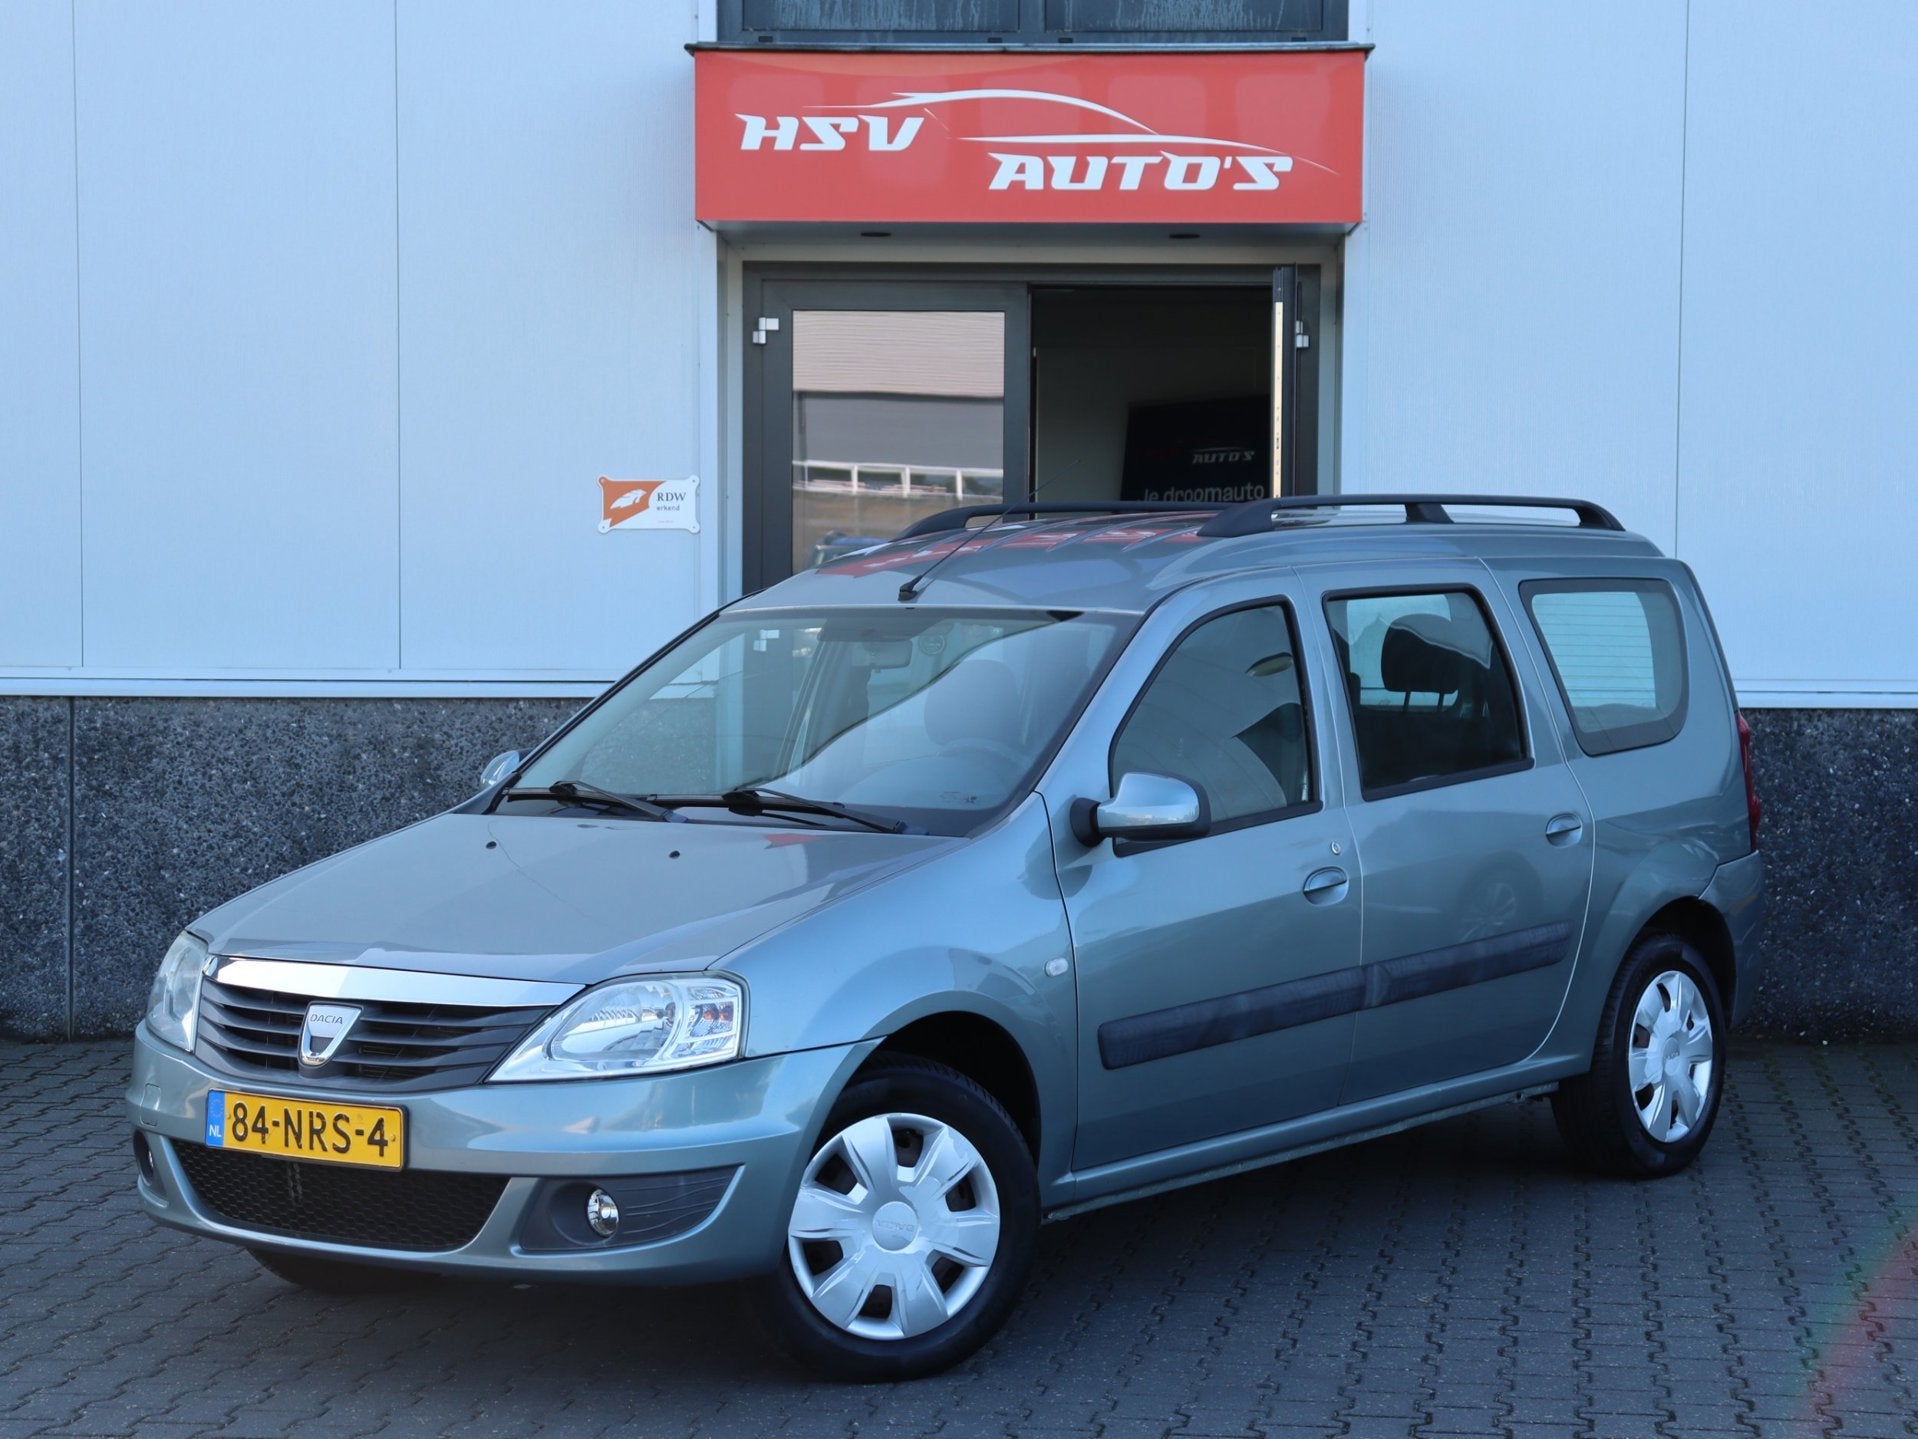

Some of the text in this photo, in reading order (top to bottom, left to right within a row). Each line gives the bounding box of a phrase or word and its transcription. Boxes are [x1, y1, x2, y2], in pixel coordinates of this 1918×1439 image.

[735, 113, 924, 151] HSV
[987, 151, 1293, 190] AUTO'S
[657, 492, 686, 501] RDW
[309, 1013, 343, 1025] DACIA
[208, 1124, 222, 1138] NL
[232, 1102, 388, 1157] 84-NRS-4
